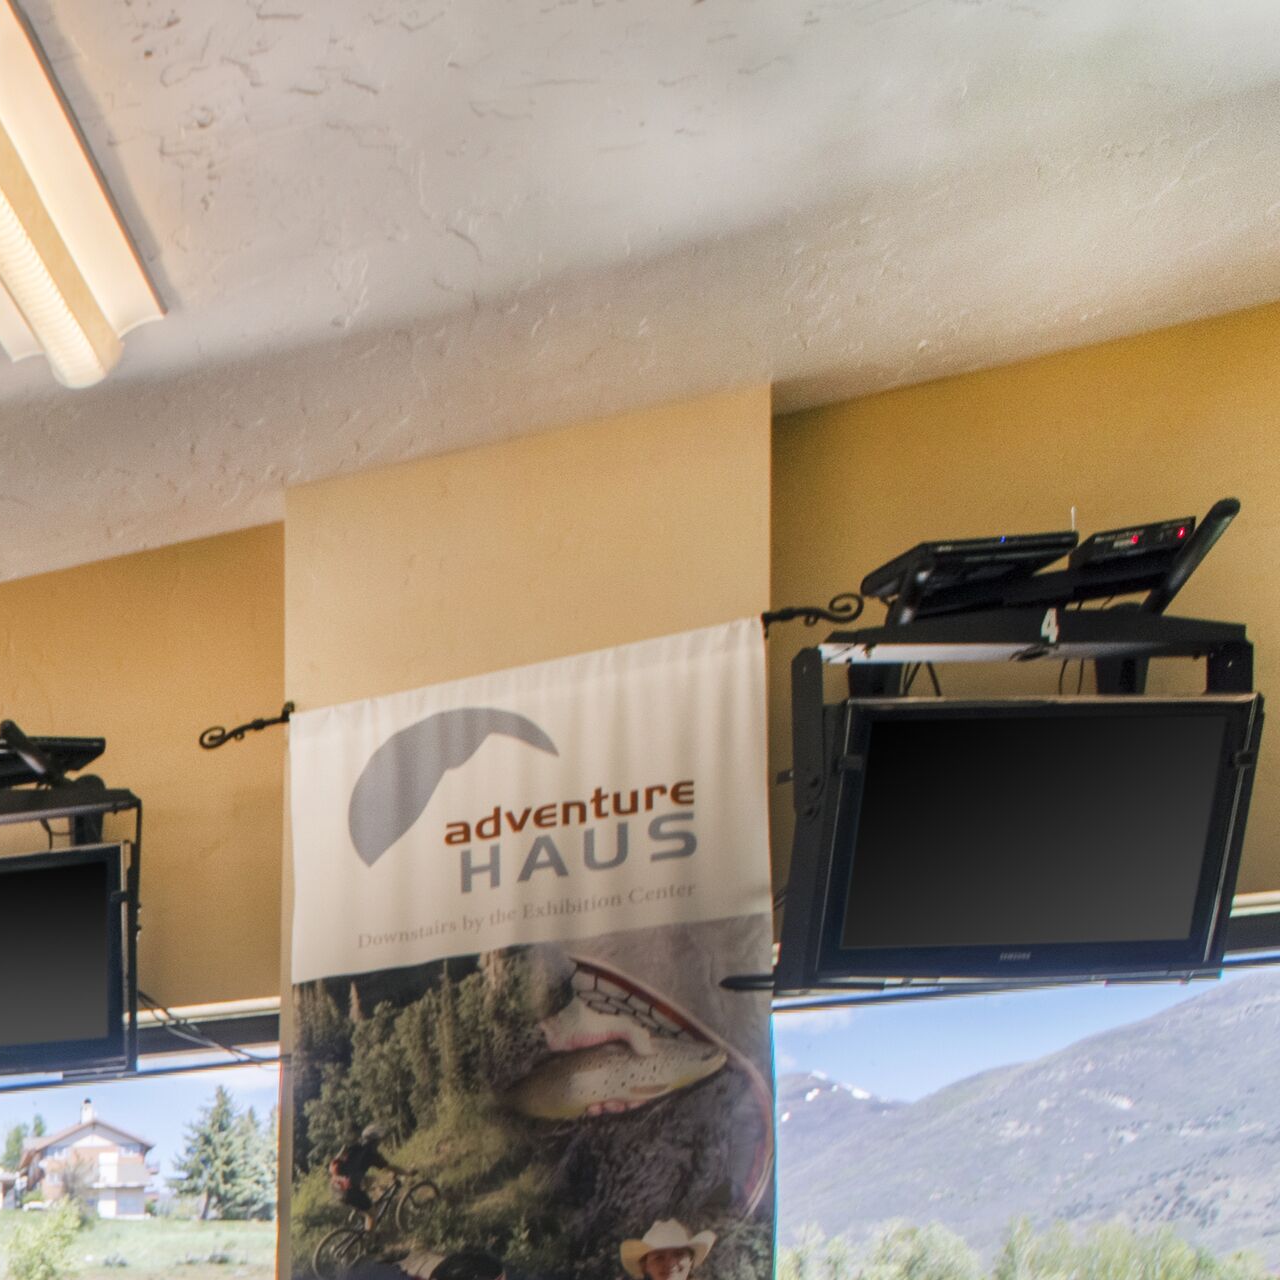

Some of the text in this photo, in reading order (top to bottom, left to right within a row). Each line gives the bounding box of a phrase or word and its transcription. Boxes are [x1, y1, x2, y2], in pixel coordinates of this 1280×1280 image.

[1040, 607, 1059, 644] 4
[444, 780, 695, 846] adventure
[460, 810, 698, 894] HAUS
[357, 883, 697, 949] Downstairs by the Exhibition Center
